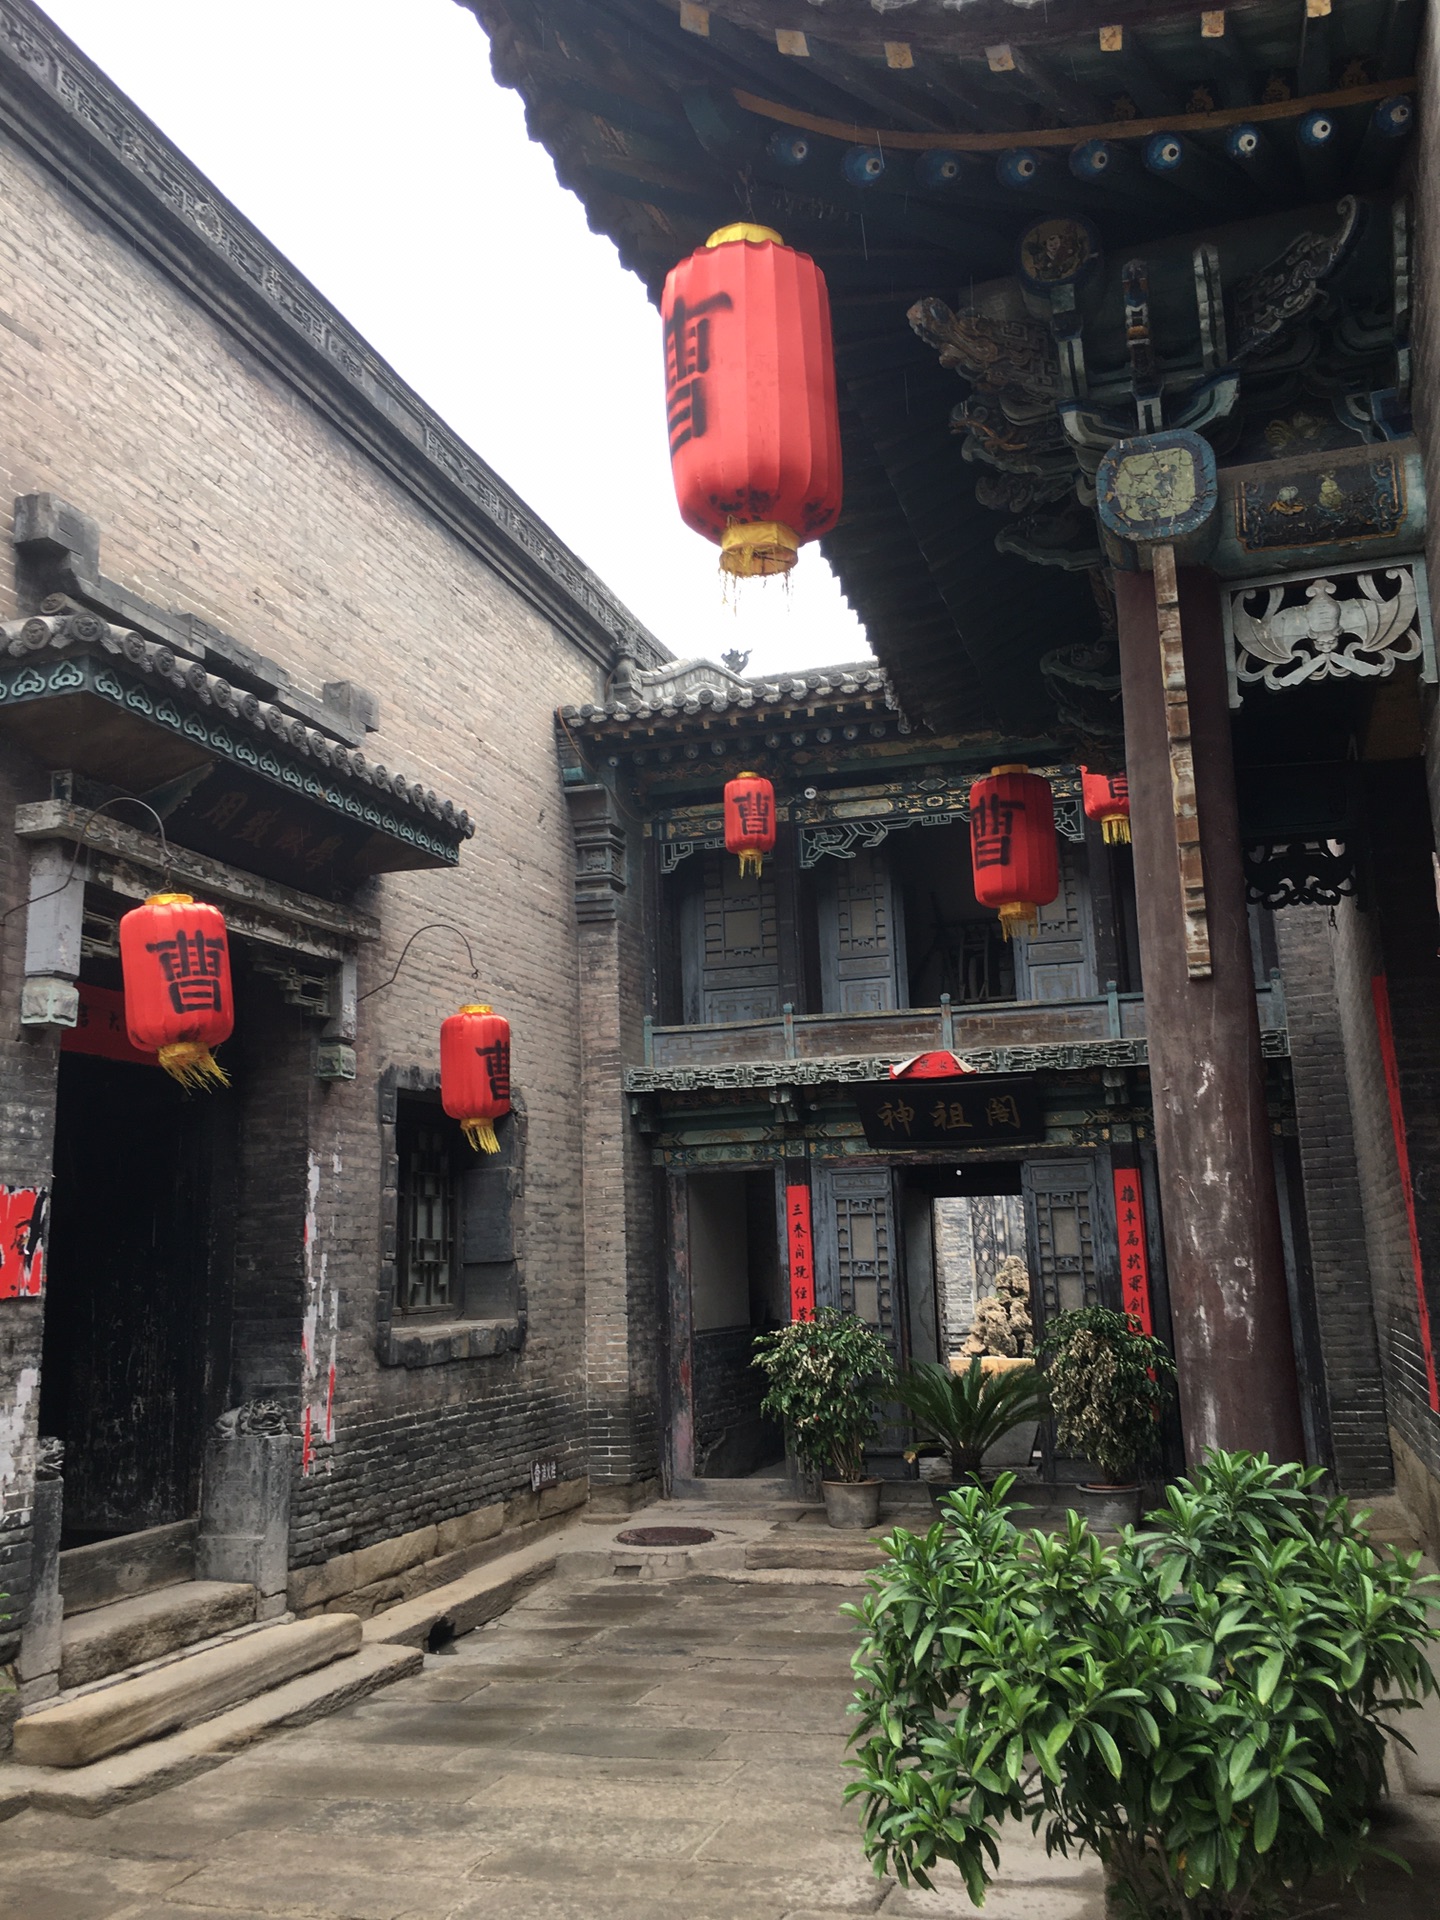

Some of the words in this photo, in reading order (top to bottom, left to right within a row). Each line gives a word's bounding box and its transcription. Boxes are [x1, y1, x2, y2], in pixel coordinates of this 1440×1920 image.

[733, 791, 770, 836] 曹
[971, 792, 1027, 870] 曹
[146, 930, 226, 1014] 曹
